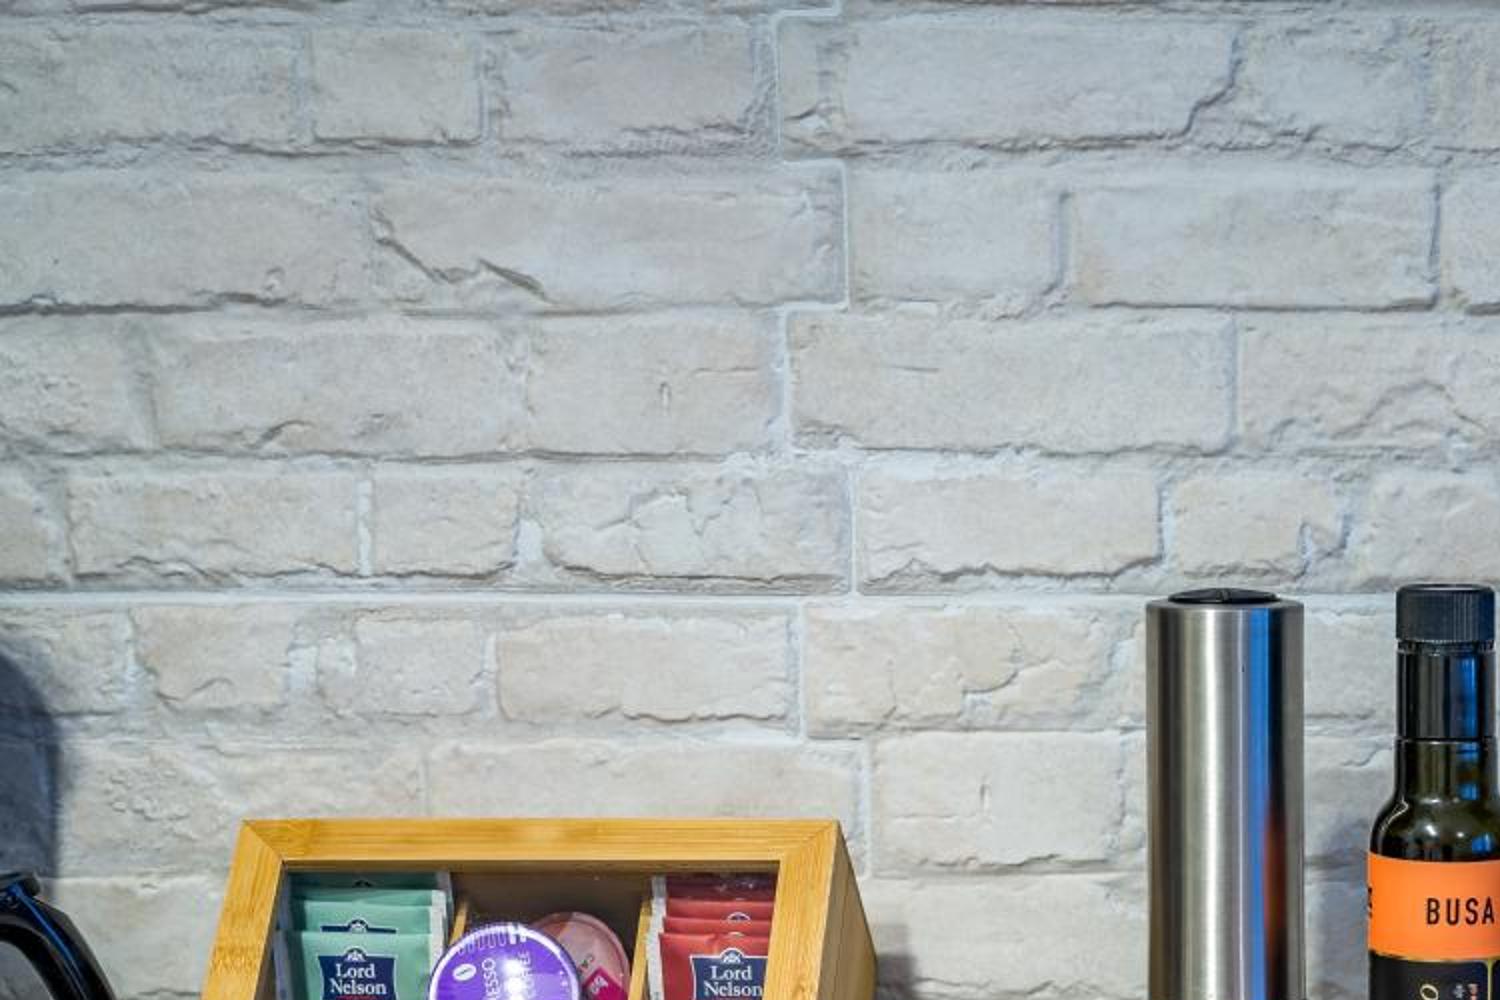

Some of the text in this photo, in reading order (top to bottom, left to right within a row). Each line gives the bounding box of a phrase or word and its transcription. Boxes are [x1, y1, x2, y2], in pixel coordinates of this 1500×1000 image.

[1425, 897, 1496, 926] BUSA
[335, 963, 376, 978] Lord
[710, 965, 753, 980] Lord
[329, 978, 388, 995] Nelson
[703, 980, 763, 997] Nelson
